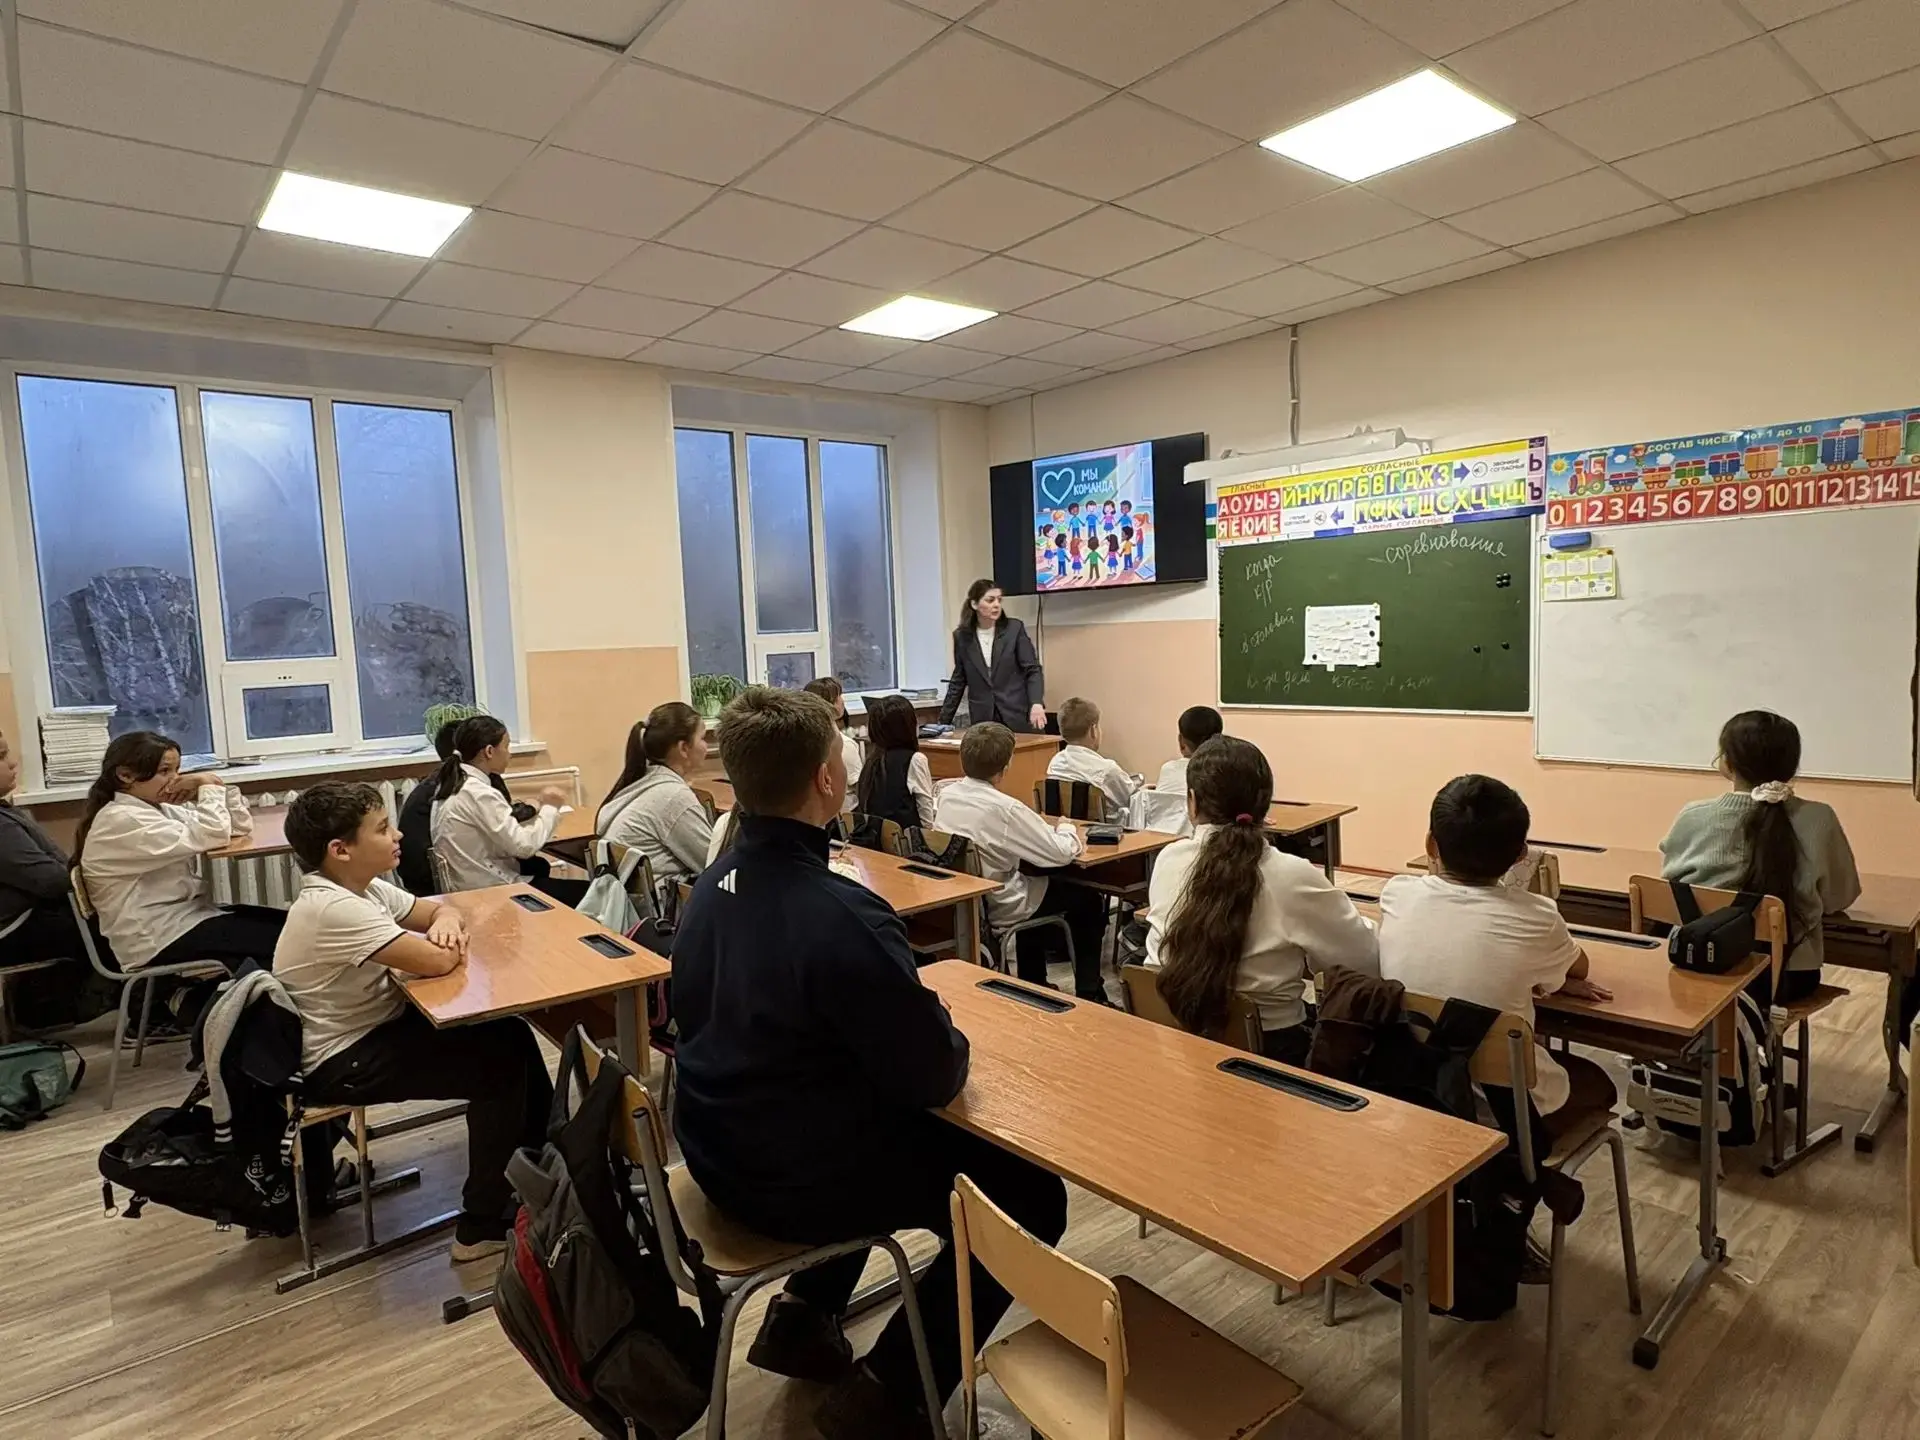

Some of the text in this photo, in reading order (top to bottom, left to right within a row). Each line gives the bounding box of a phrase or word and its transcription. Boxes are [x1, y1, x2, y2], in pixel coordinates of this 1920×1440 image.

[1648, 440, 1694, 453] СОСТАВ
[1697, 432, 1738, 447] ЧИСЕЛ
[1777, 429, 1793, 437] до
[1797, 425, 1812, 434] 10
[1081, 467, 1098, 482] МЫ
[1360, 459, 1420, 474] СОГЛАСНЫЕ
[1073, 480, 1114, 496] КОМАНДА
[1550, 504, 1565, 526] 0
[1571, 502, 1583, 524] 1
[1588, 500, 1604, 522] 2
[1608, 498, 1624, 520] 3
[1628, 496, 1647, 518] 4
[1651, 494, 1669, 517] 5
[1672, 492, 1692, 515] 6
[1696, 490, 1714, 514] 7
[1718, 487, 1737, 511] 8
[1742, 485, 1762, 510] 9
[1766, 482, 1790, 508] 10
[1792, 480, 1815, 505] 11
[1818, 477, 1843, 504] 12
[1845, 475, 1871, 501] 13
[1873, 473, 1899, 499] 14
[1385, 528, 1507, 574] соревнование
[1245, 554, 1283, 581] когда
